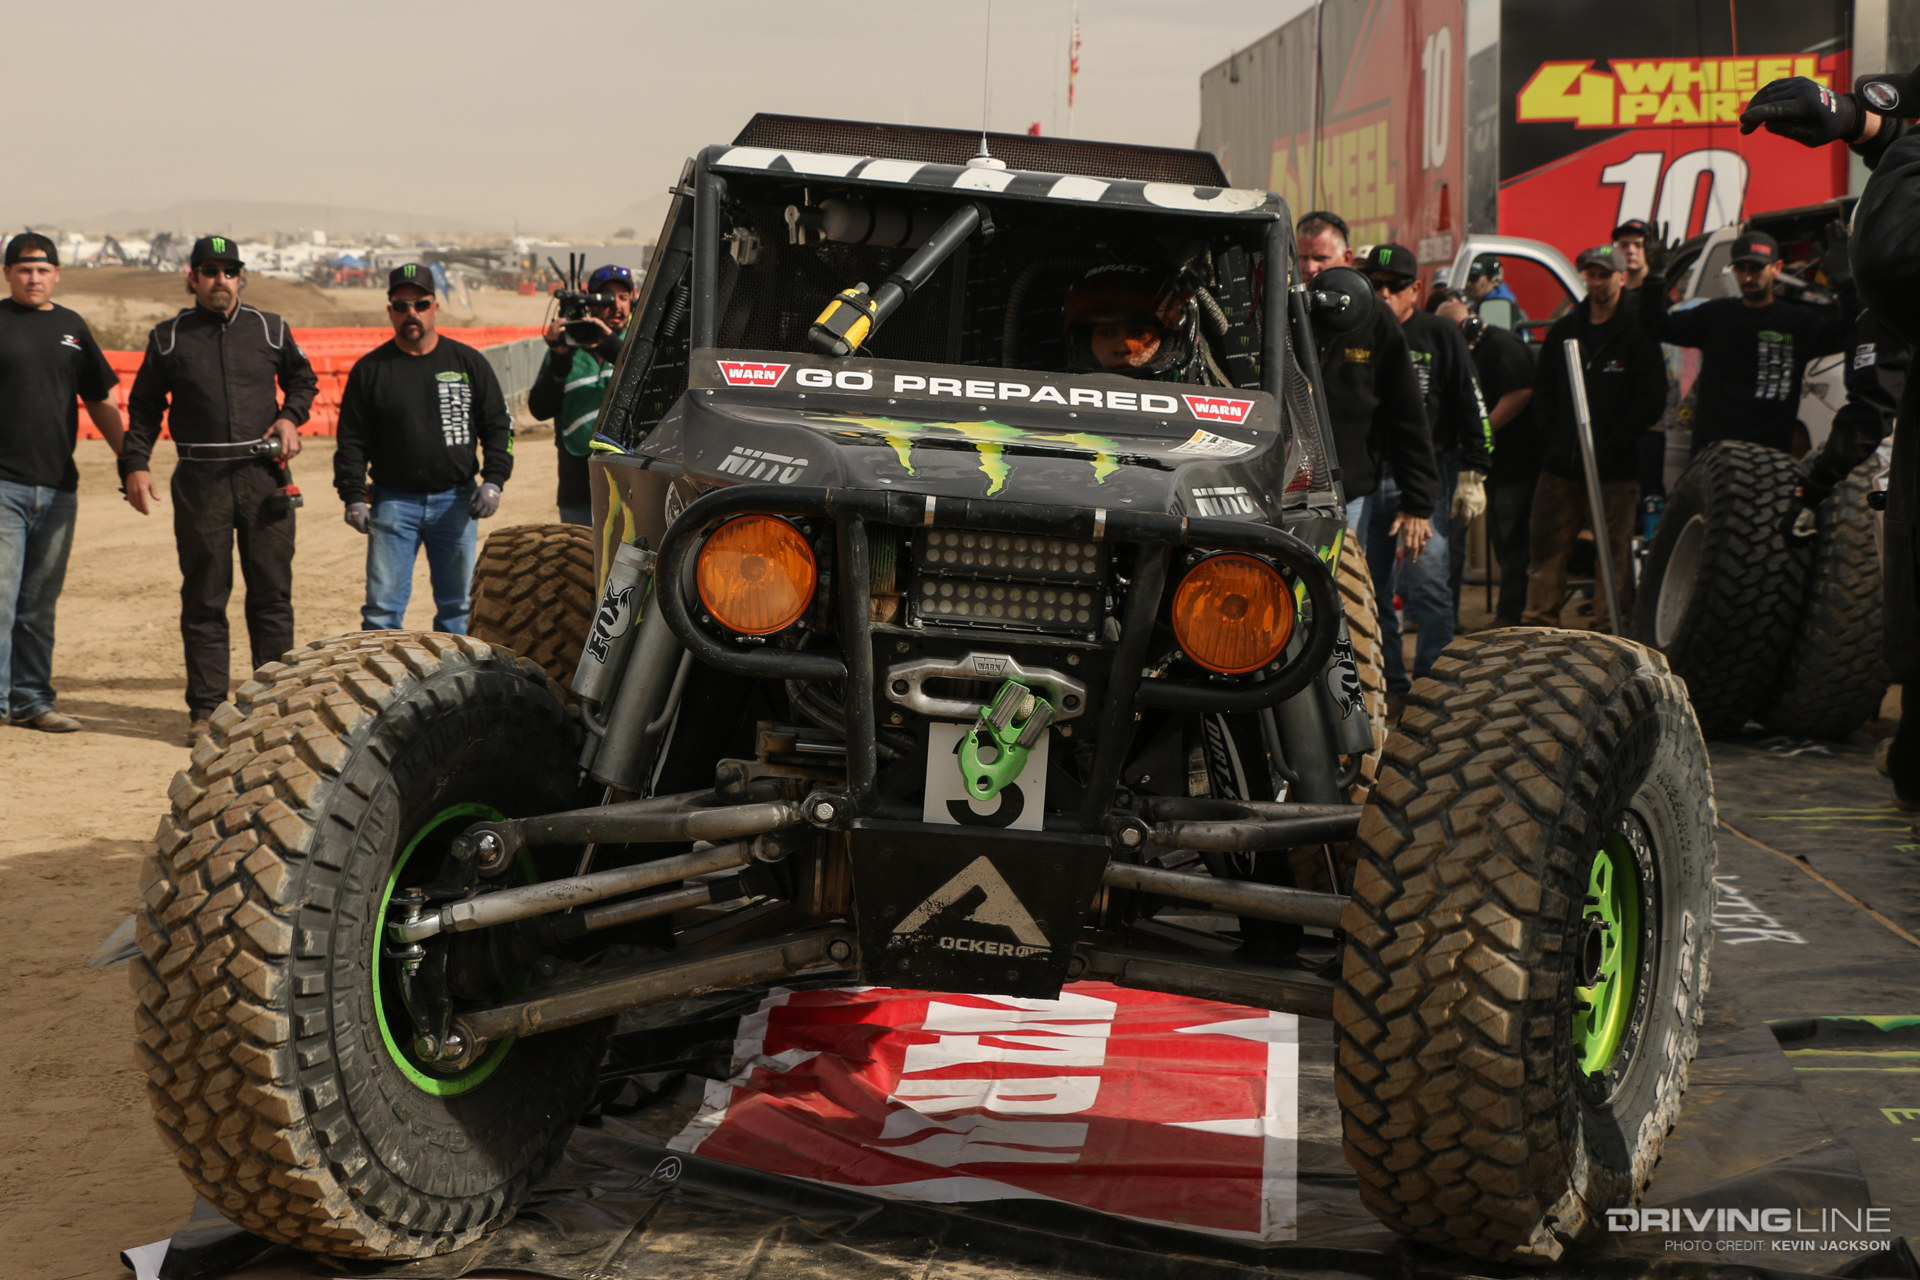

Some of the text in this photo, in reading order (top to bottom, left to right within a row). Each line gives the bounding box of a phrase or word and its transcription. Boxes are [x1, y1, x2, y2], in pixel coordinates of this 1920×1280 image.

[1421, 26, 1452, 170] 10
[1519, 58, 1833, 125] 4 WHEEL
[1601, 150, 1749, 248] 10
[1084, 263, 1151, 279] IMPACT
[728, 367, 777, 381] WARN
[796, 368, 1179, 414] GO PREPARED
[1193, 402, 1243, 417] WARN
[716, 446, 809, 485] NITTO
[1192, 486, 1254, 517] NITTO
[586, 579, 628, 665] FOX
[977, 661, 1001, 672] WARN
[1331, 639, 1367, 714] FOX
[1204, 717, 1233, 784] DIRT
[861, 989, 1117, 1164] WARN
